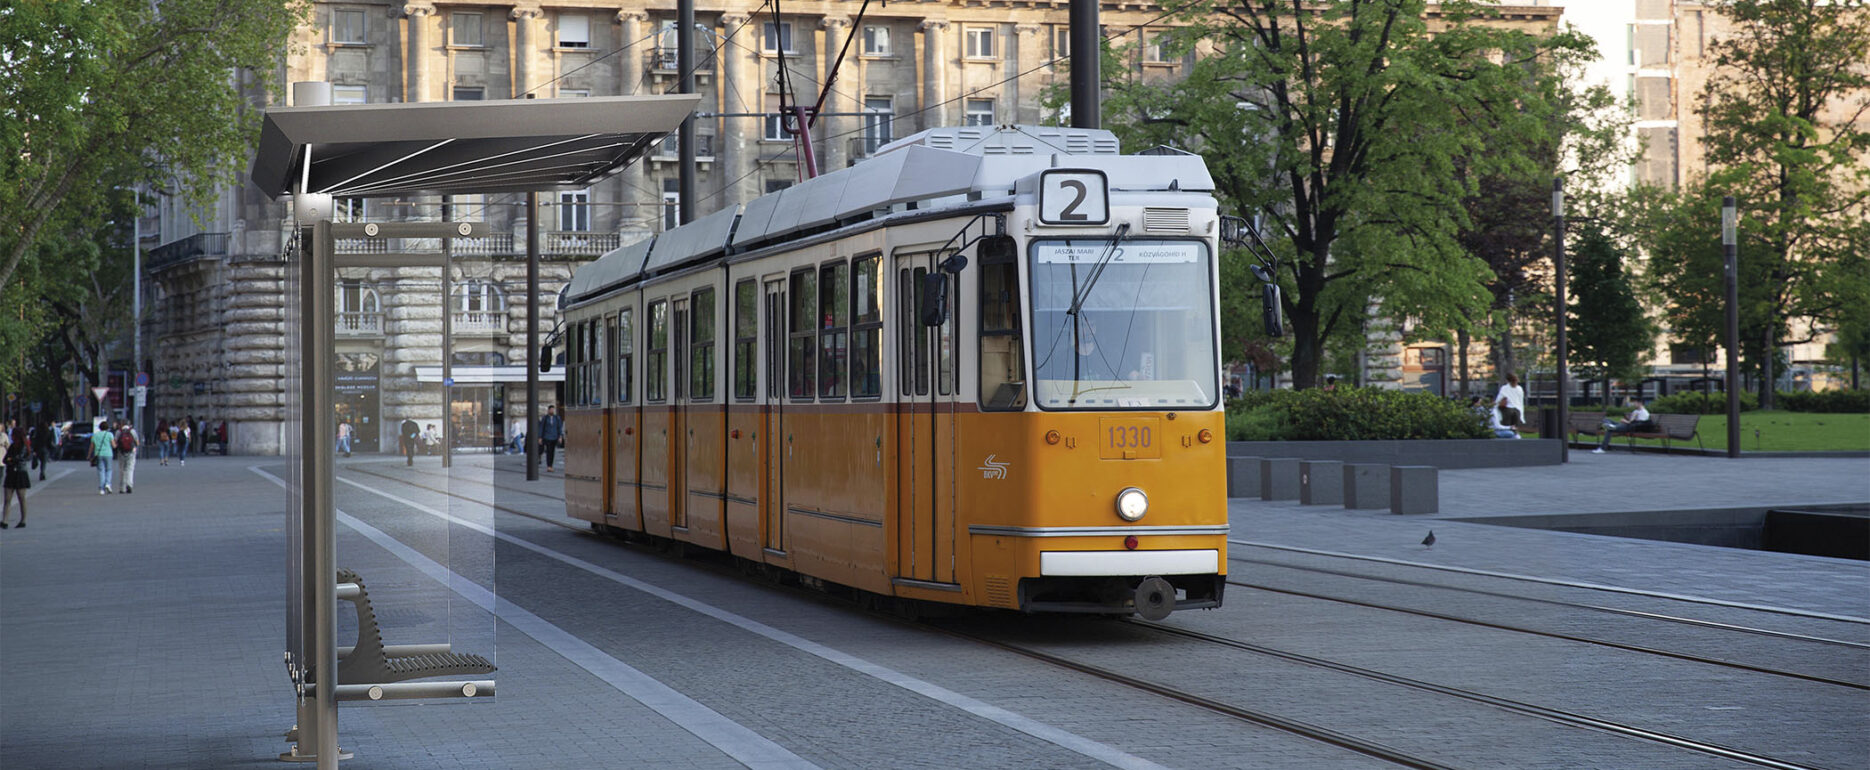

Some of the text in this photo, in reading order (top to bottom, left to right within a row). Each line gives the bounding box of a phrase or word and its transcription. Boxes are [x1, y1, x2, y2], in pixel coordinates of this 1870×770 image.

[1059, 179, 1088, 220] 2
[1113, 247, 1124, 261] 2
[1109, 426, 1151, 448] 1330
